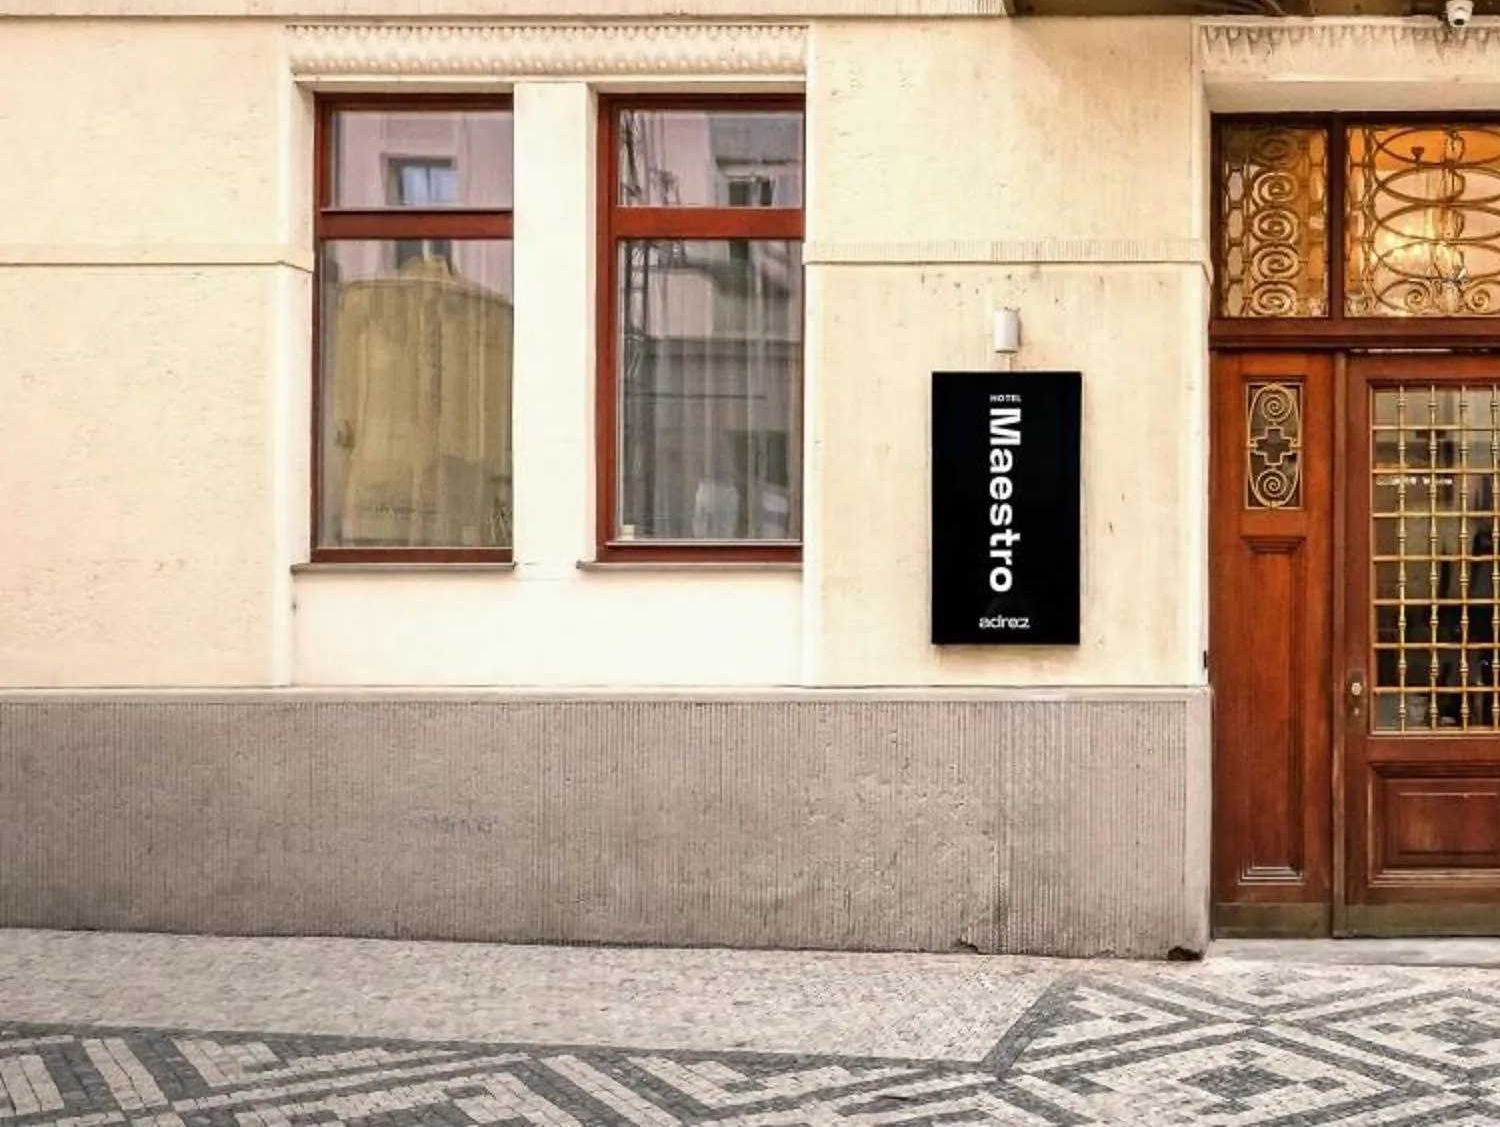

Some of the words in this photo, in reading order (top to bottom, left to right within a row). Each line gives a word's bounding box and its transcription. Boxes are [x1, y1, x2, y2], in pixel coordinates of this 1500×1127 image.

[989, 394, 1021, 402] HOTEL
[989, 408, 1021, 592] Maestro
[979, 614, 1030, 629] adrez
